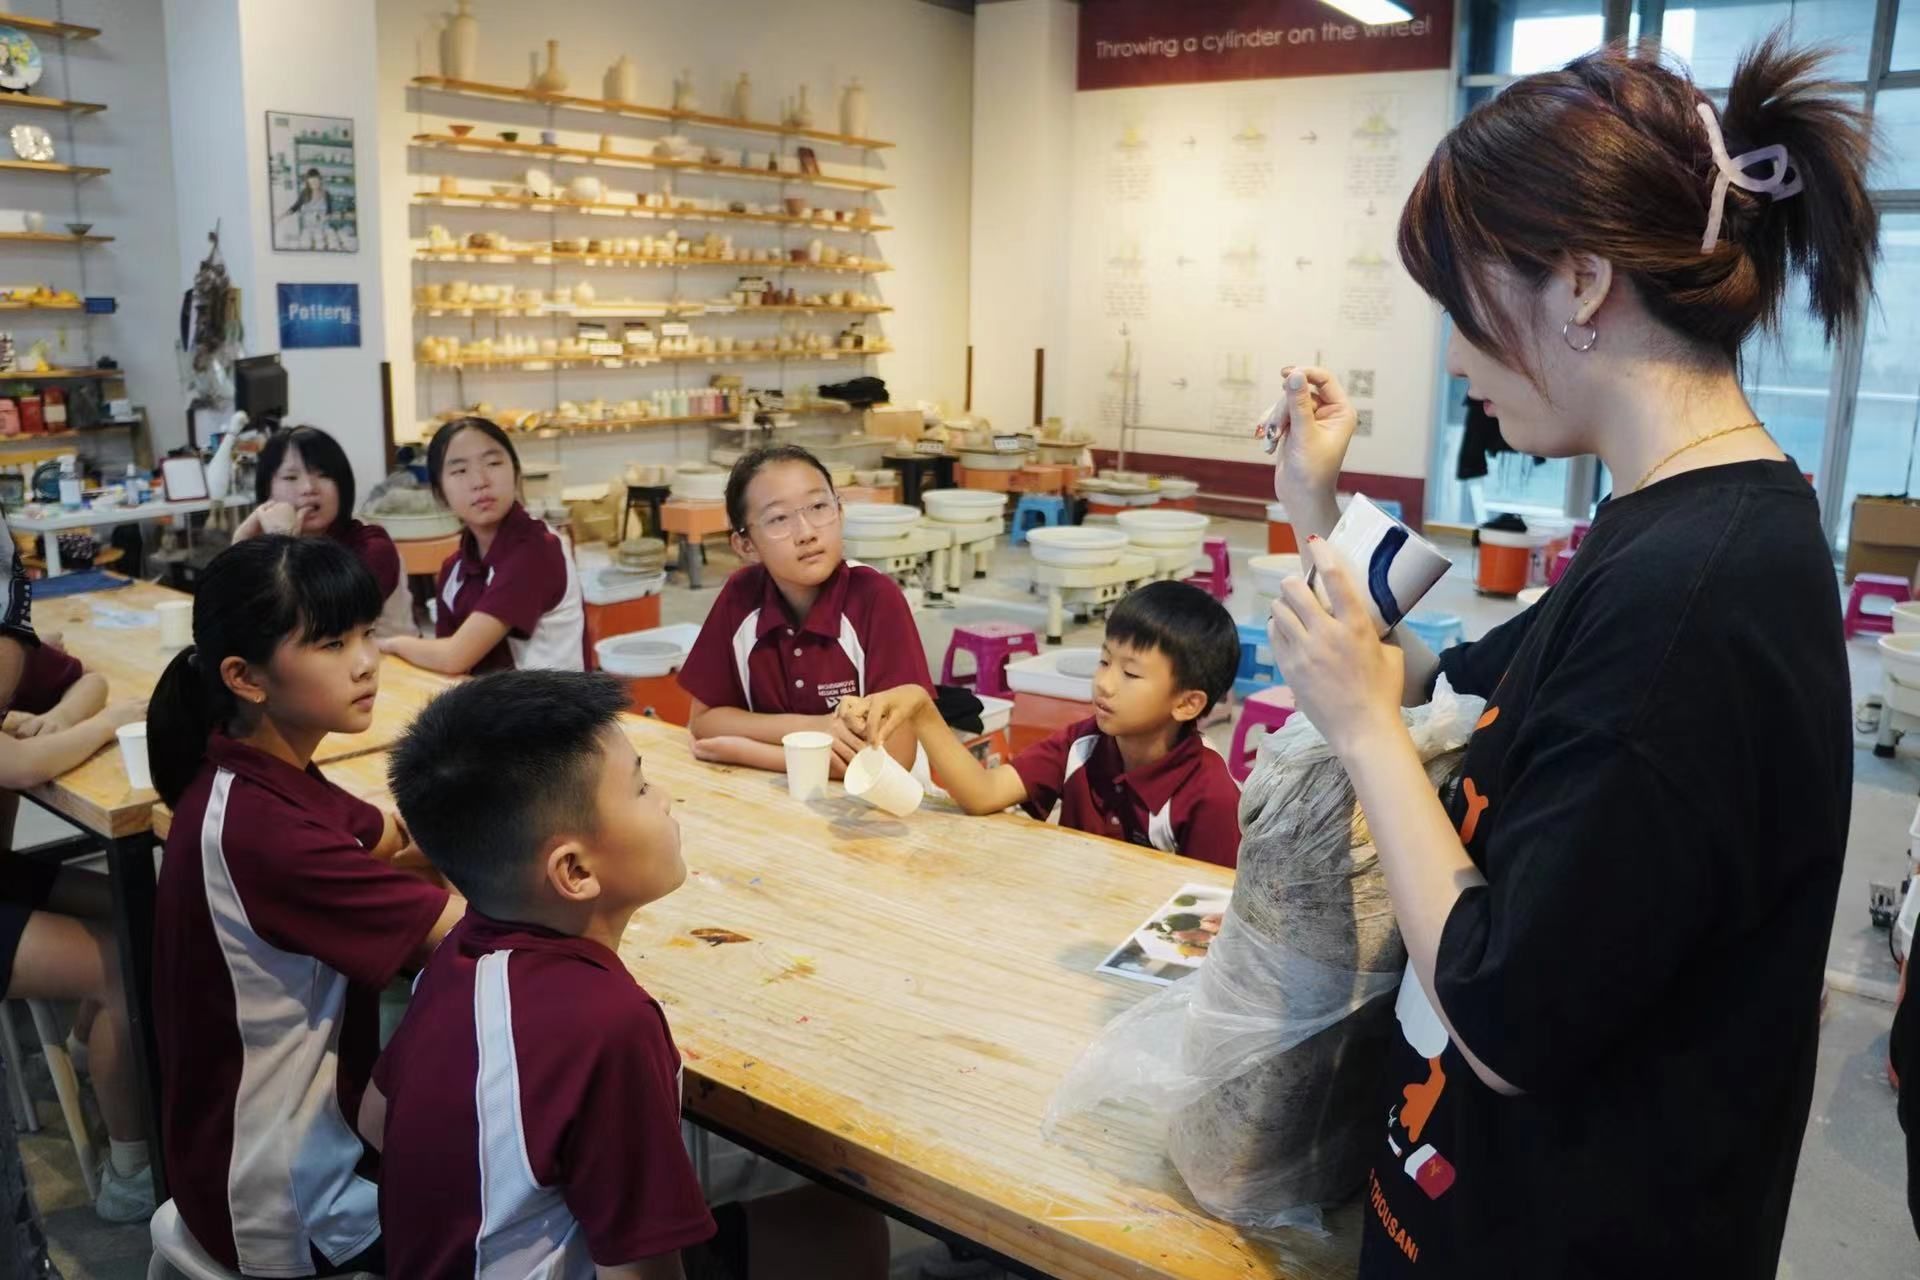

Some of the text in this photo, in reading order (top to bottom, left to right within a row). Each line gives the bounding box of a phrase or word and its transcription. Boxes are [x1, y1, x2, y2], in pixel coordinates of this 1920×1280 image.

[1096, 15, 1431, 58] Throwing a cylinder on the wheel
[288, 303, 352, 325] Pottery
